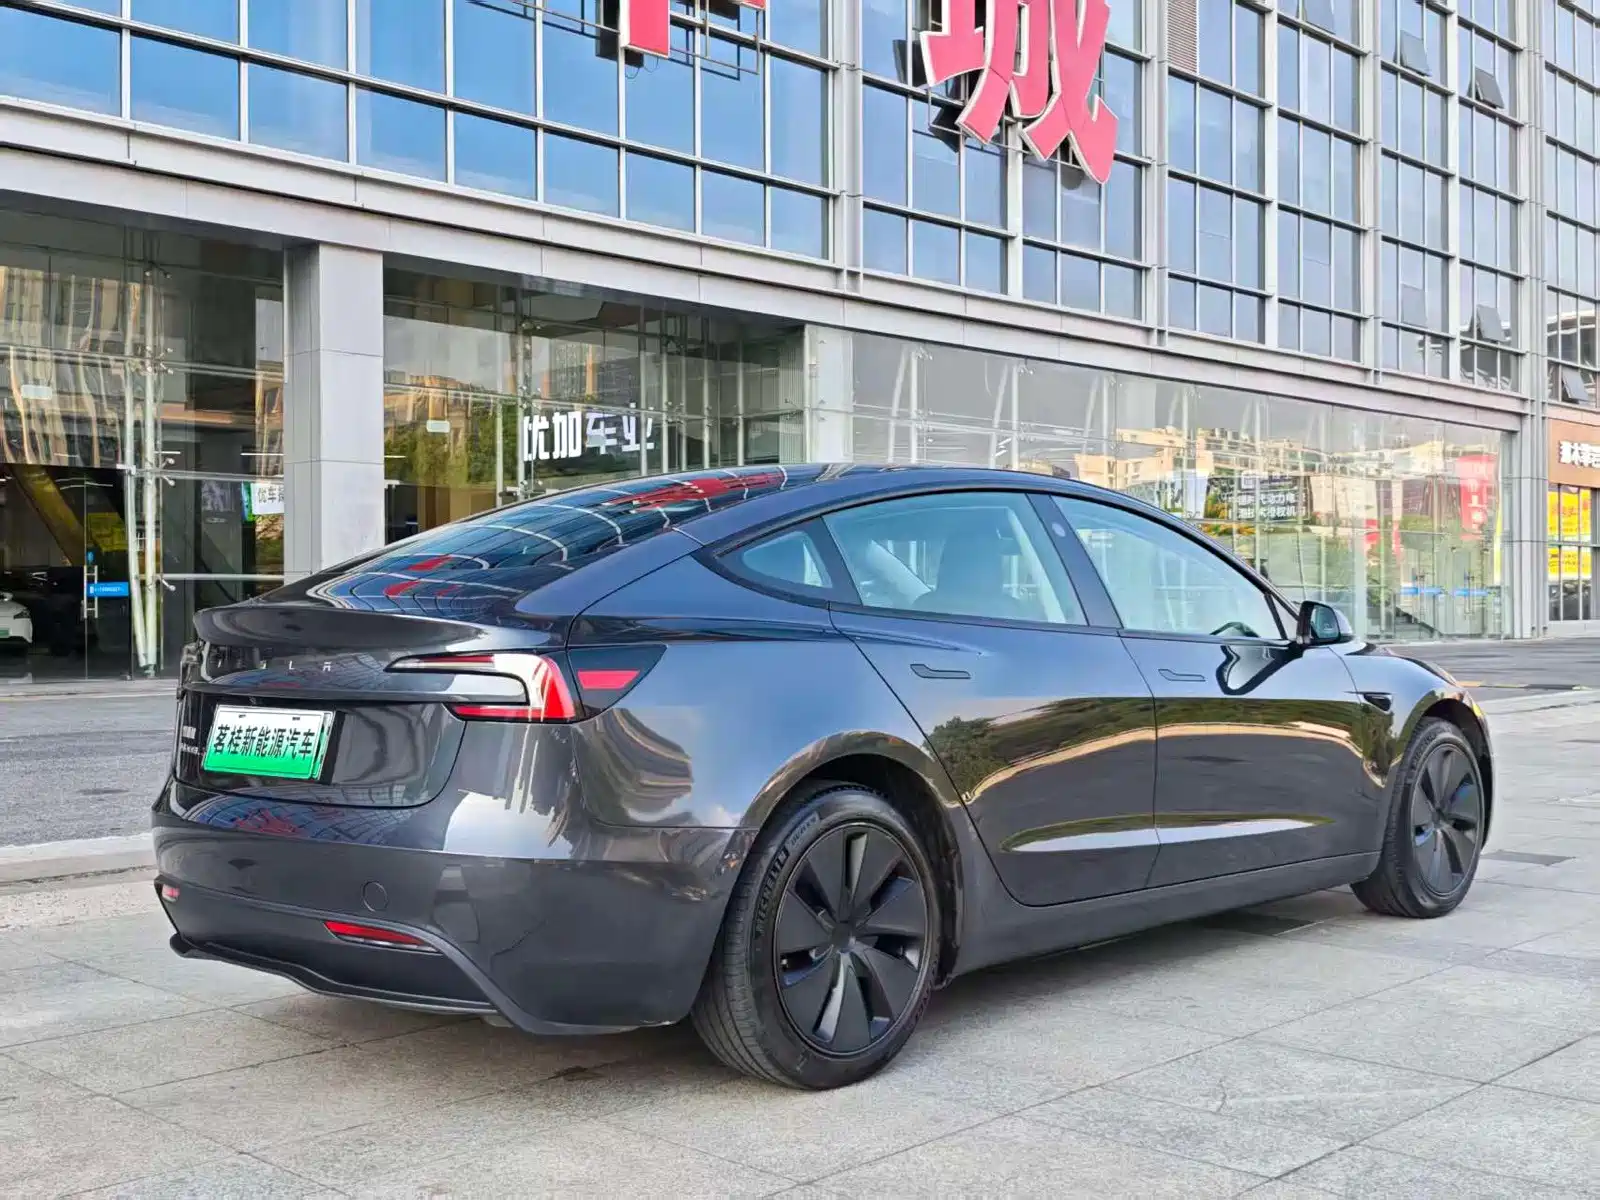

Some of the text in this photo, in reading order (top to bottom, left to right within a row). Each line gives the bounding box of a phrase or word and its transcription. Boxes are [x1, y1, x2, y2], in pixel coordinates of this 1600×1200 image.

[213, 723, 315, 760] 茗桂新能源汽车
